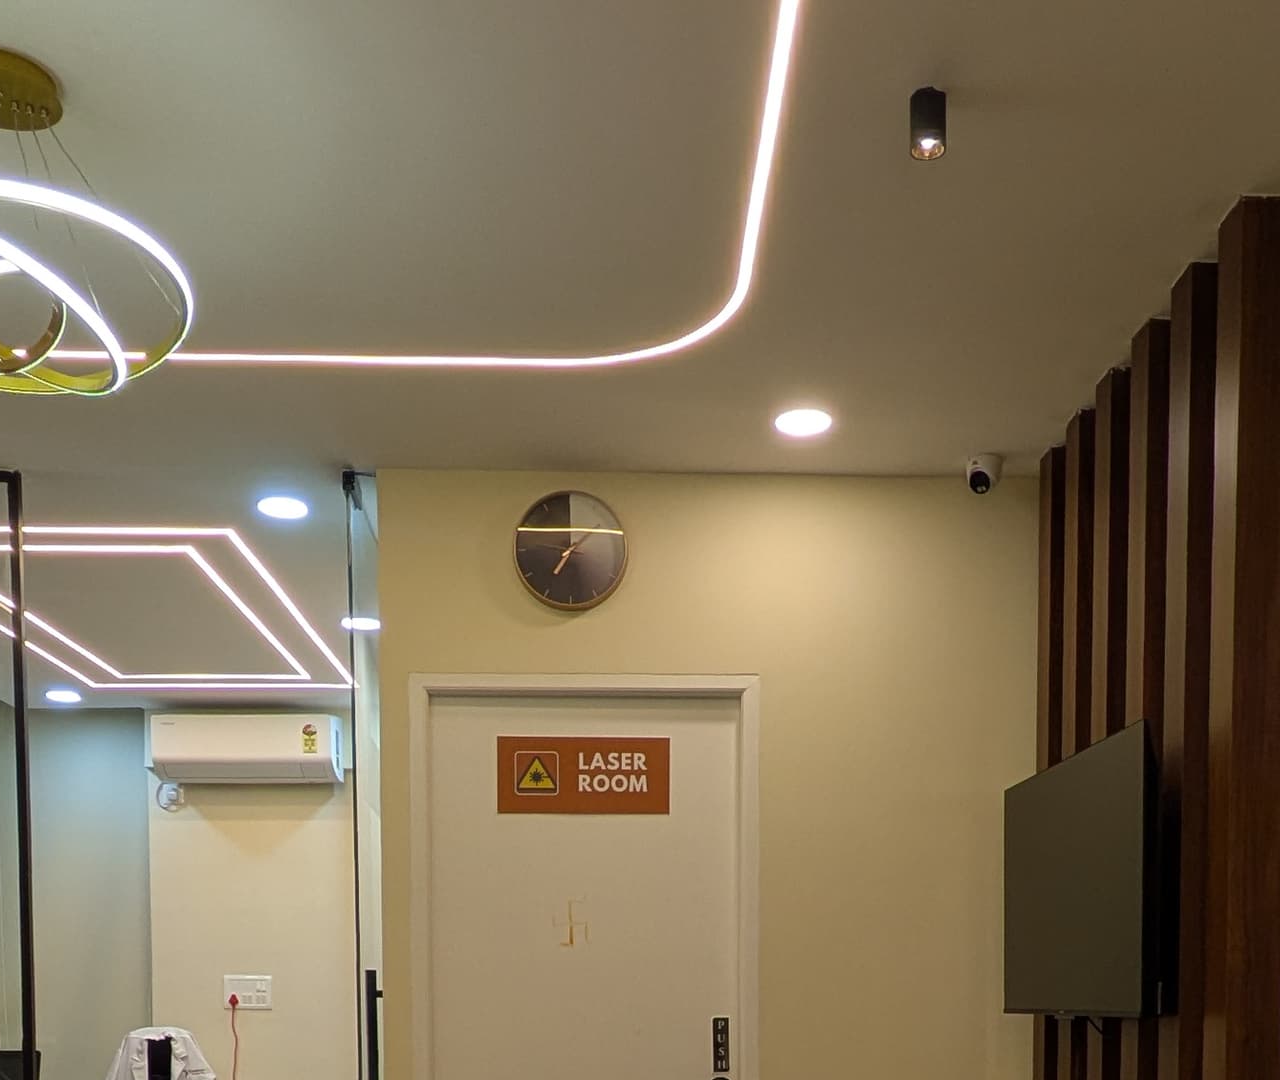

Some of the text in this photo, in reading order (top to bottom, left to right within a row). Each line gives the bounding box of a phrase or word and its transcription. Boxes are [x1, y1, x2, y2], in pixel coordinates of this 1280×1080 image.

[578, 752, 647, 771] LASER
[578, 774, 648, 793] ROOM
[717, 1020, 726, 1070] PUSH
